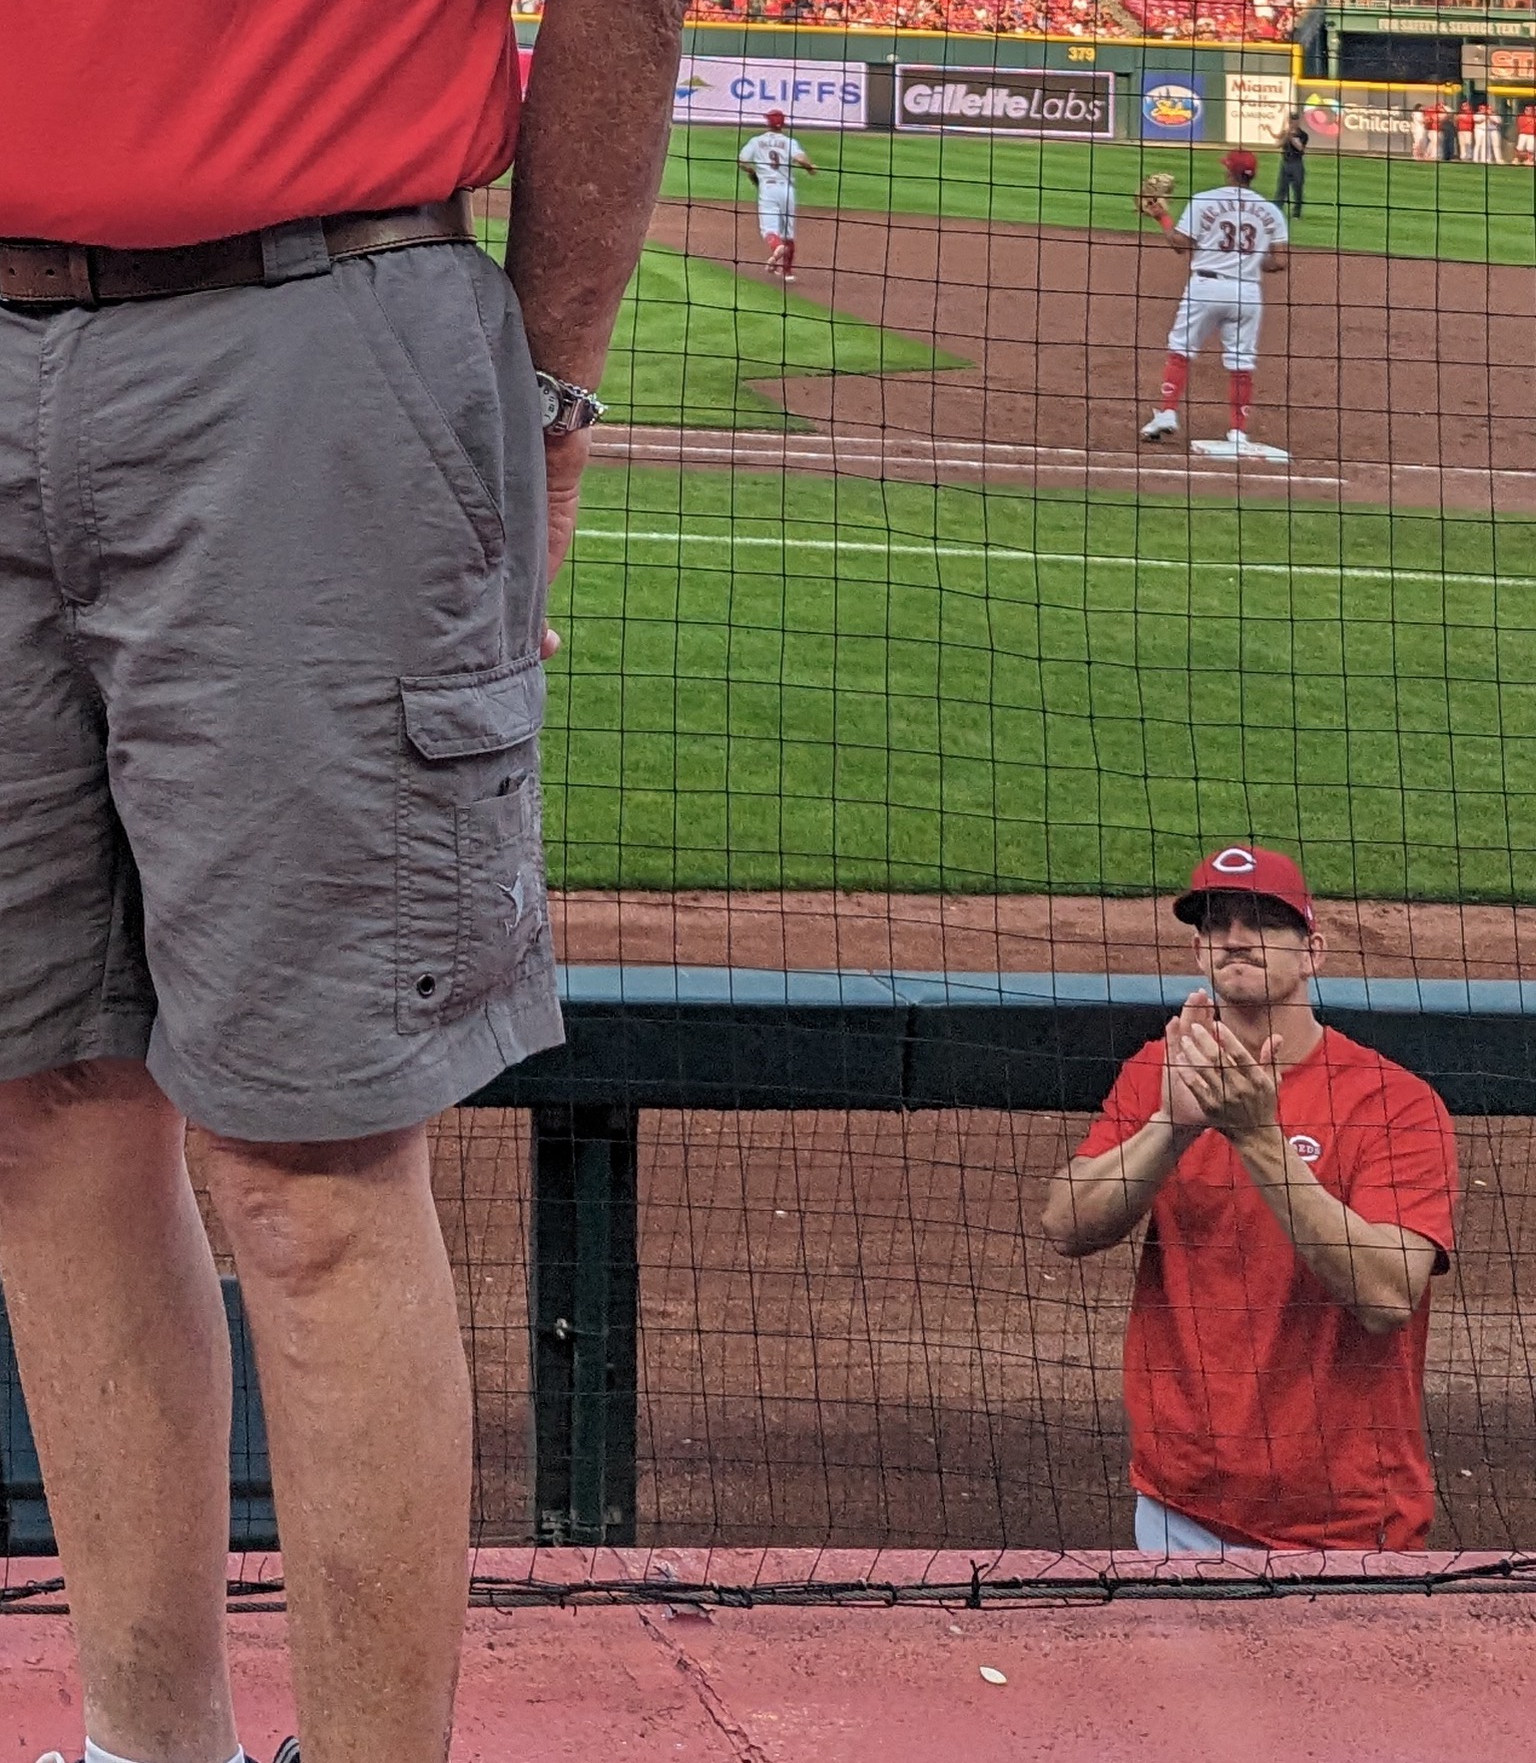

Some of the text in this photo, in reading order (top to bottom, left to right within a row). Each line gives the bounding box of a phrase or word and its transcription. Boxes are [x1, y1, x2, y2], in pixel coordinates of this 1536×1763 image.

[1067, 46, 1096, 62] 379
[730, 77, 862, 105] CLIFFS
[1231, 79, 1284, 94] Miami
[1218, 220, 1257, 256] 33
